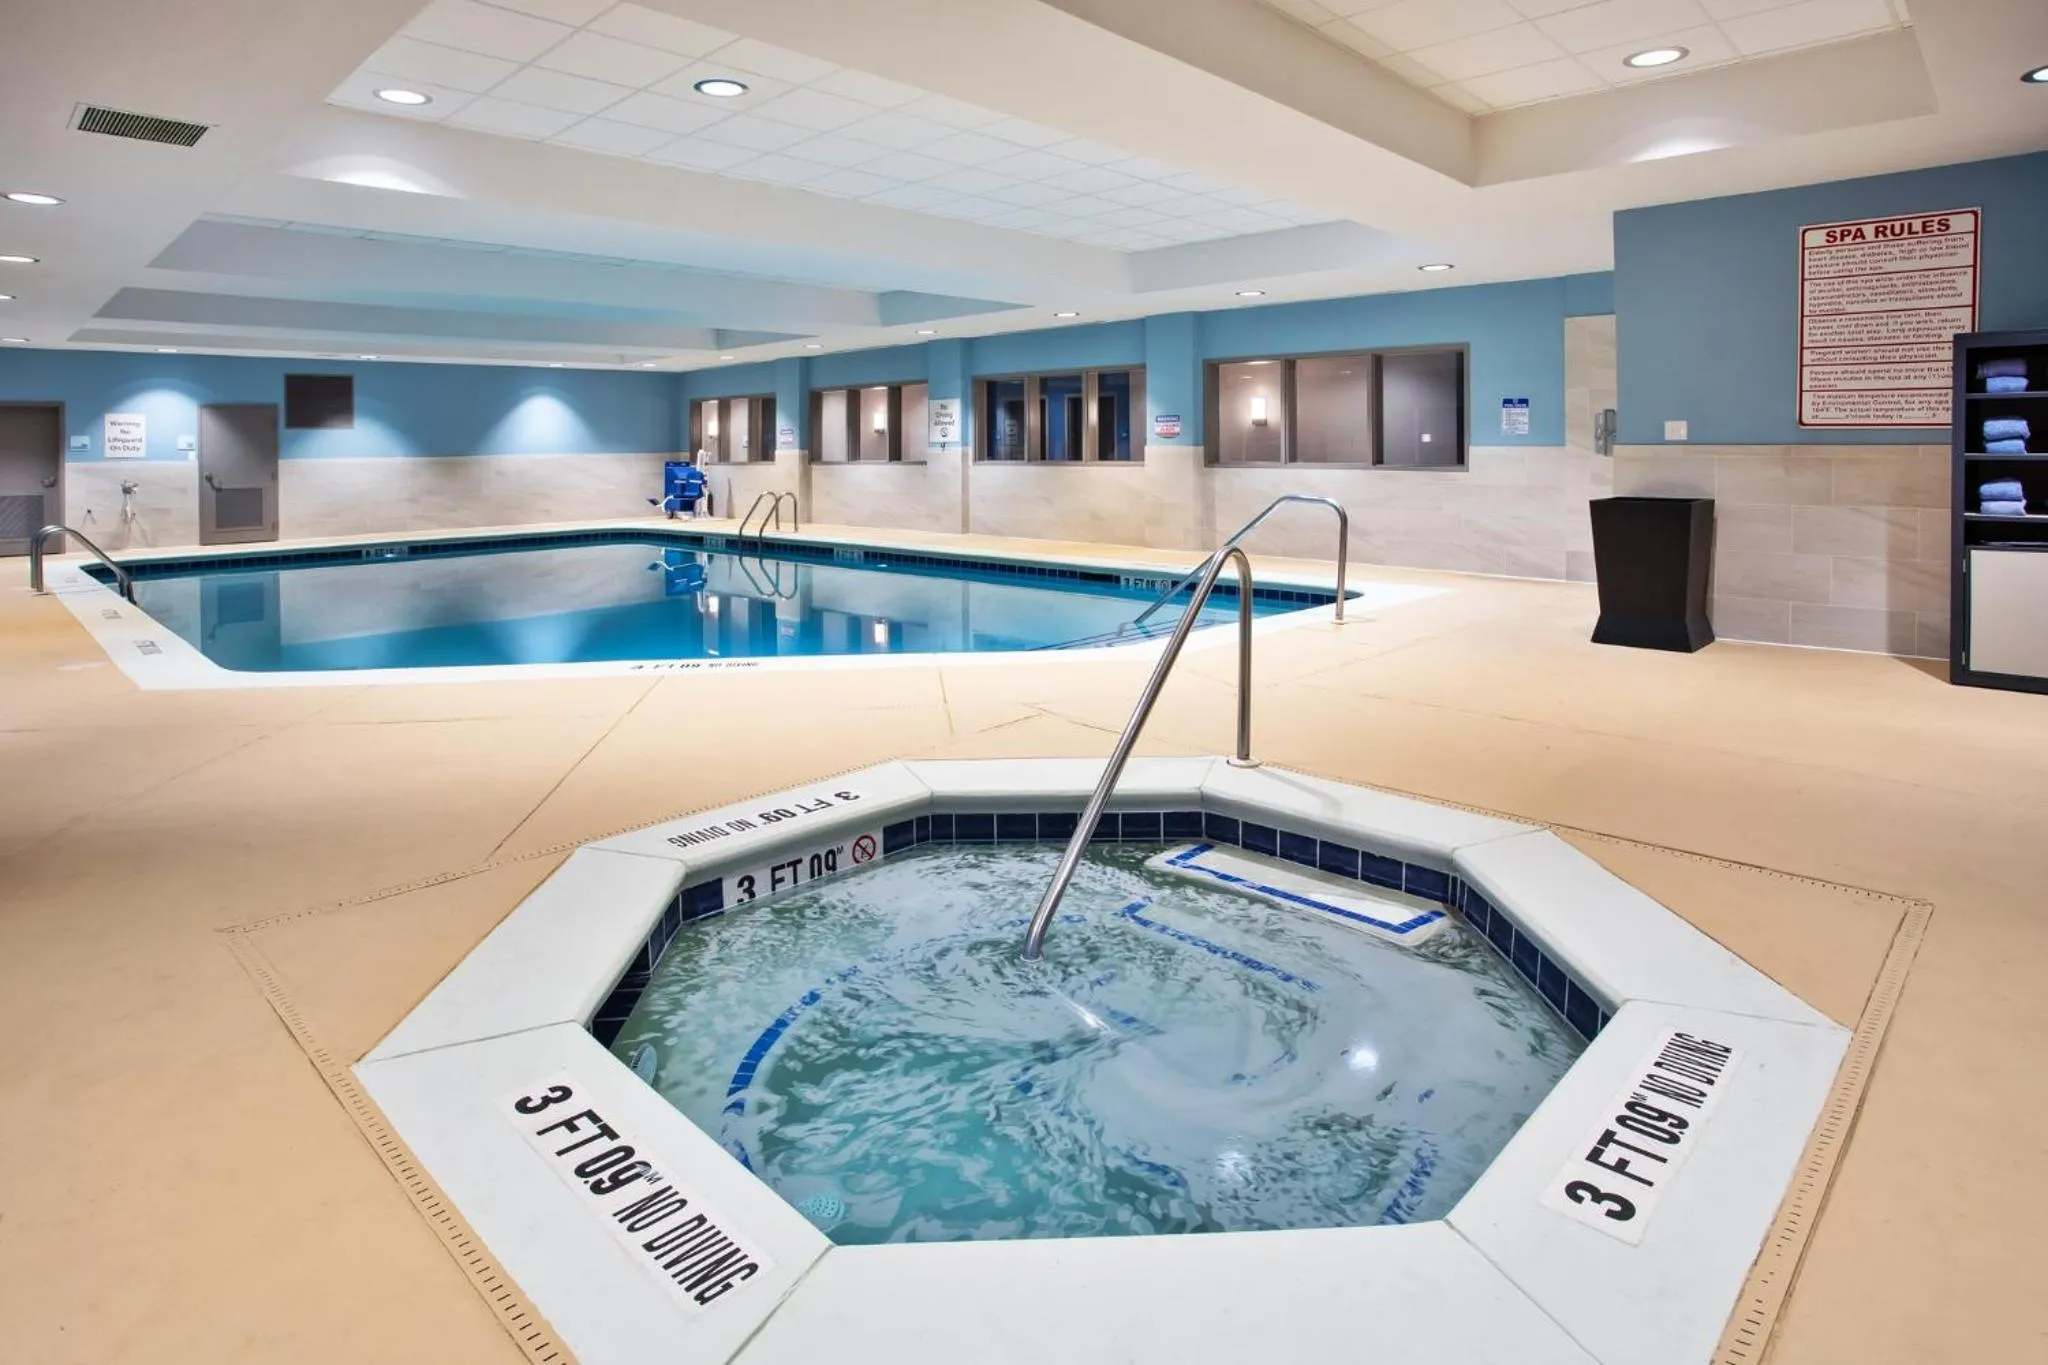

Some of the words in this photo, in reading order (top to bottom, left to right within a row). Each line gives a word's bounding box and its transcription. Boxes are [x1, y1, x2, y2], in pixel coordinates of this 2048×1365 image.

[1826, 228, 1866, 244] SPA
[1874, 218, 1950, 239] RULES
[796, 798, 834, 814] FT
[834, 790, 860, 802] 3
[667, 826, 730, 848] DIVING
[726, 818, 758, 832] NO
[736, 874, 756, 904] 3
[770, 858, 803, 893] FT
[1654, 1032, 1732, 1086] DIVING
[514, 1084, 573, 1114] 3
[1639, 1074, 1708, 1108] NO
[536, 1108, 620, 1157] FT
[1584, 1128, 1668, 1188] FT
[612, 1184, 688, 1234] NO
[1564, 1180, 1636, 1222] 3
[642, 1213, 759, 1306] DIVING
